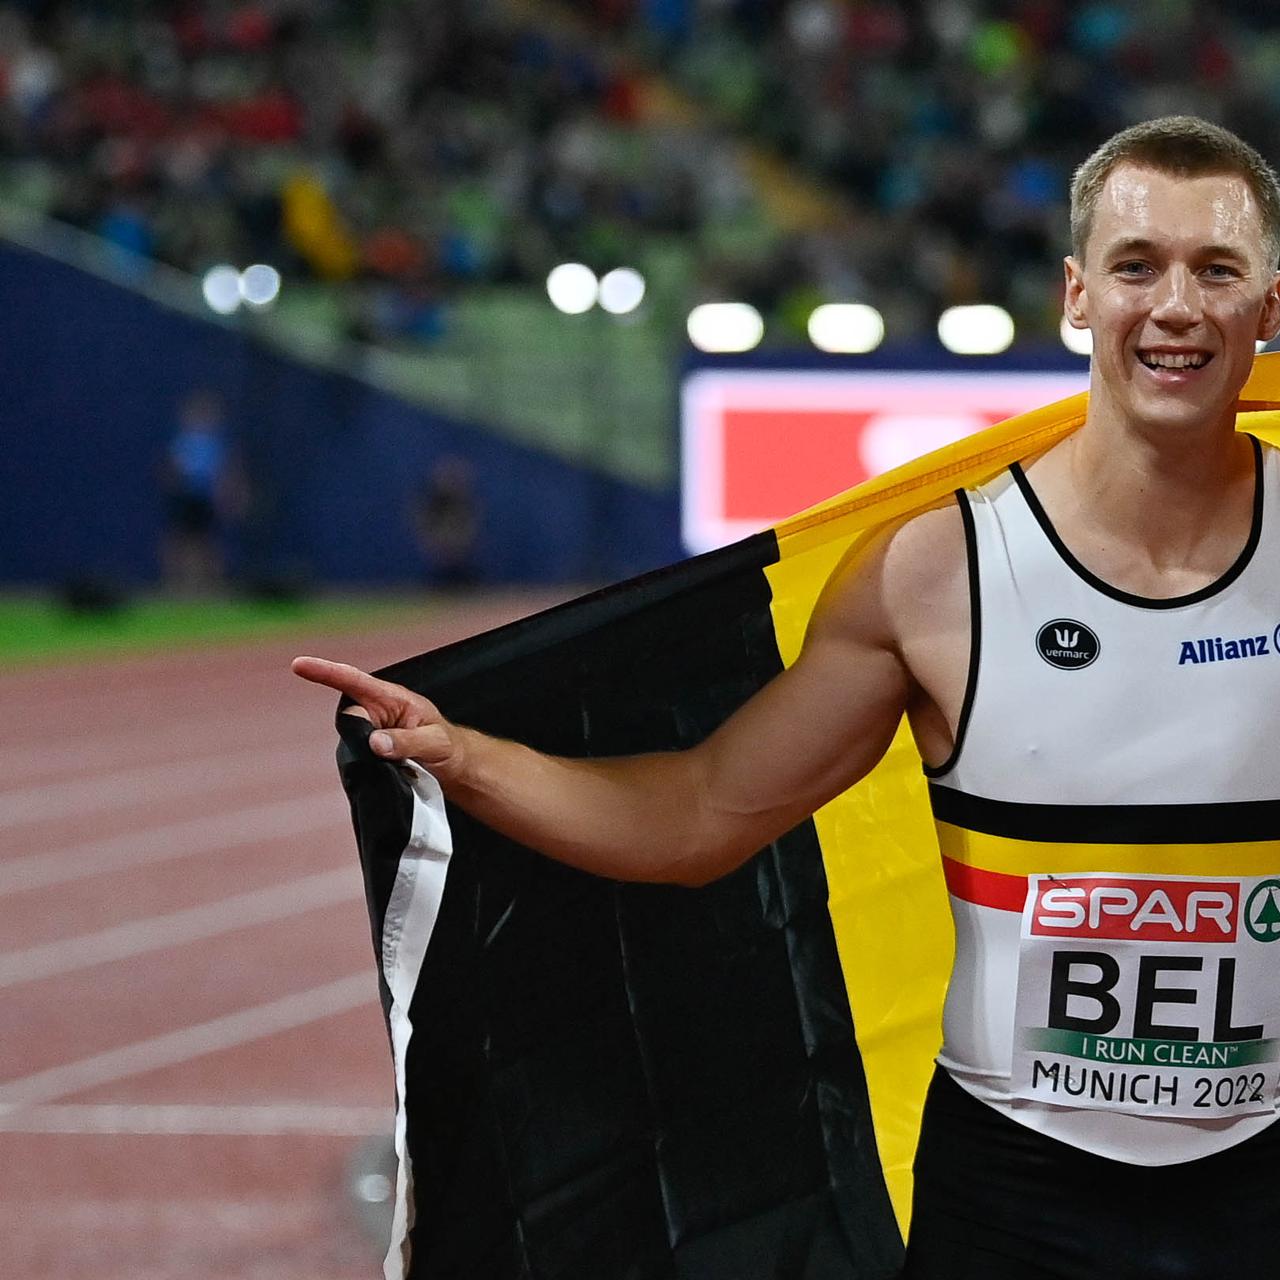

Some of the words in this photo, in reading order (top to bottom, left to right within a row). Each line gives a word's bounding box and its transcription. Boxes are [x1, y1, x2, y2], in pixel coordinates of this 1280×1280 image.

[1045, 648, 1089, 660] vermarc
[1178, 633, 1270, 665] Allianz
[1038, 887, 1233, 935] SPAR
[1046, 950, 1264, 1043] BEL
[1081, 1038, 1088, 1057] I
[1095, 1040, 1146, 1062] RUN
[1031, 1060, 1179, 1107] MUNICH
[1194, 1073, 1266, 1108] 2022
